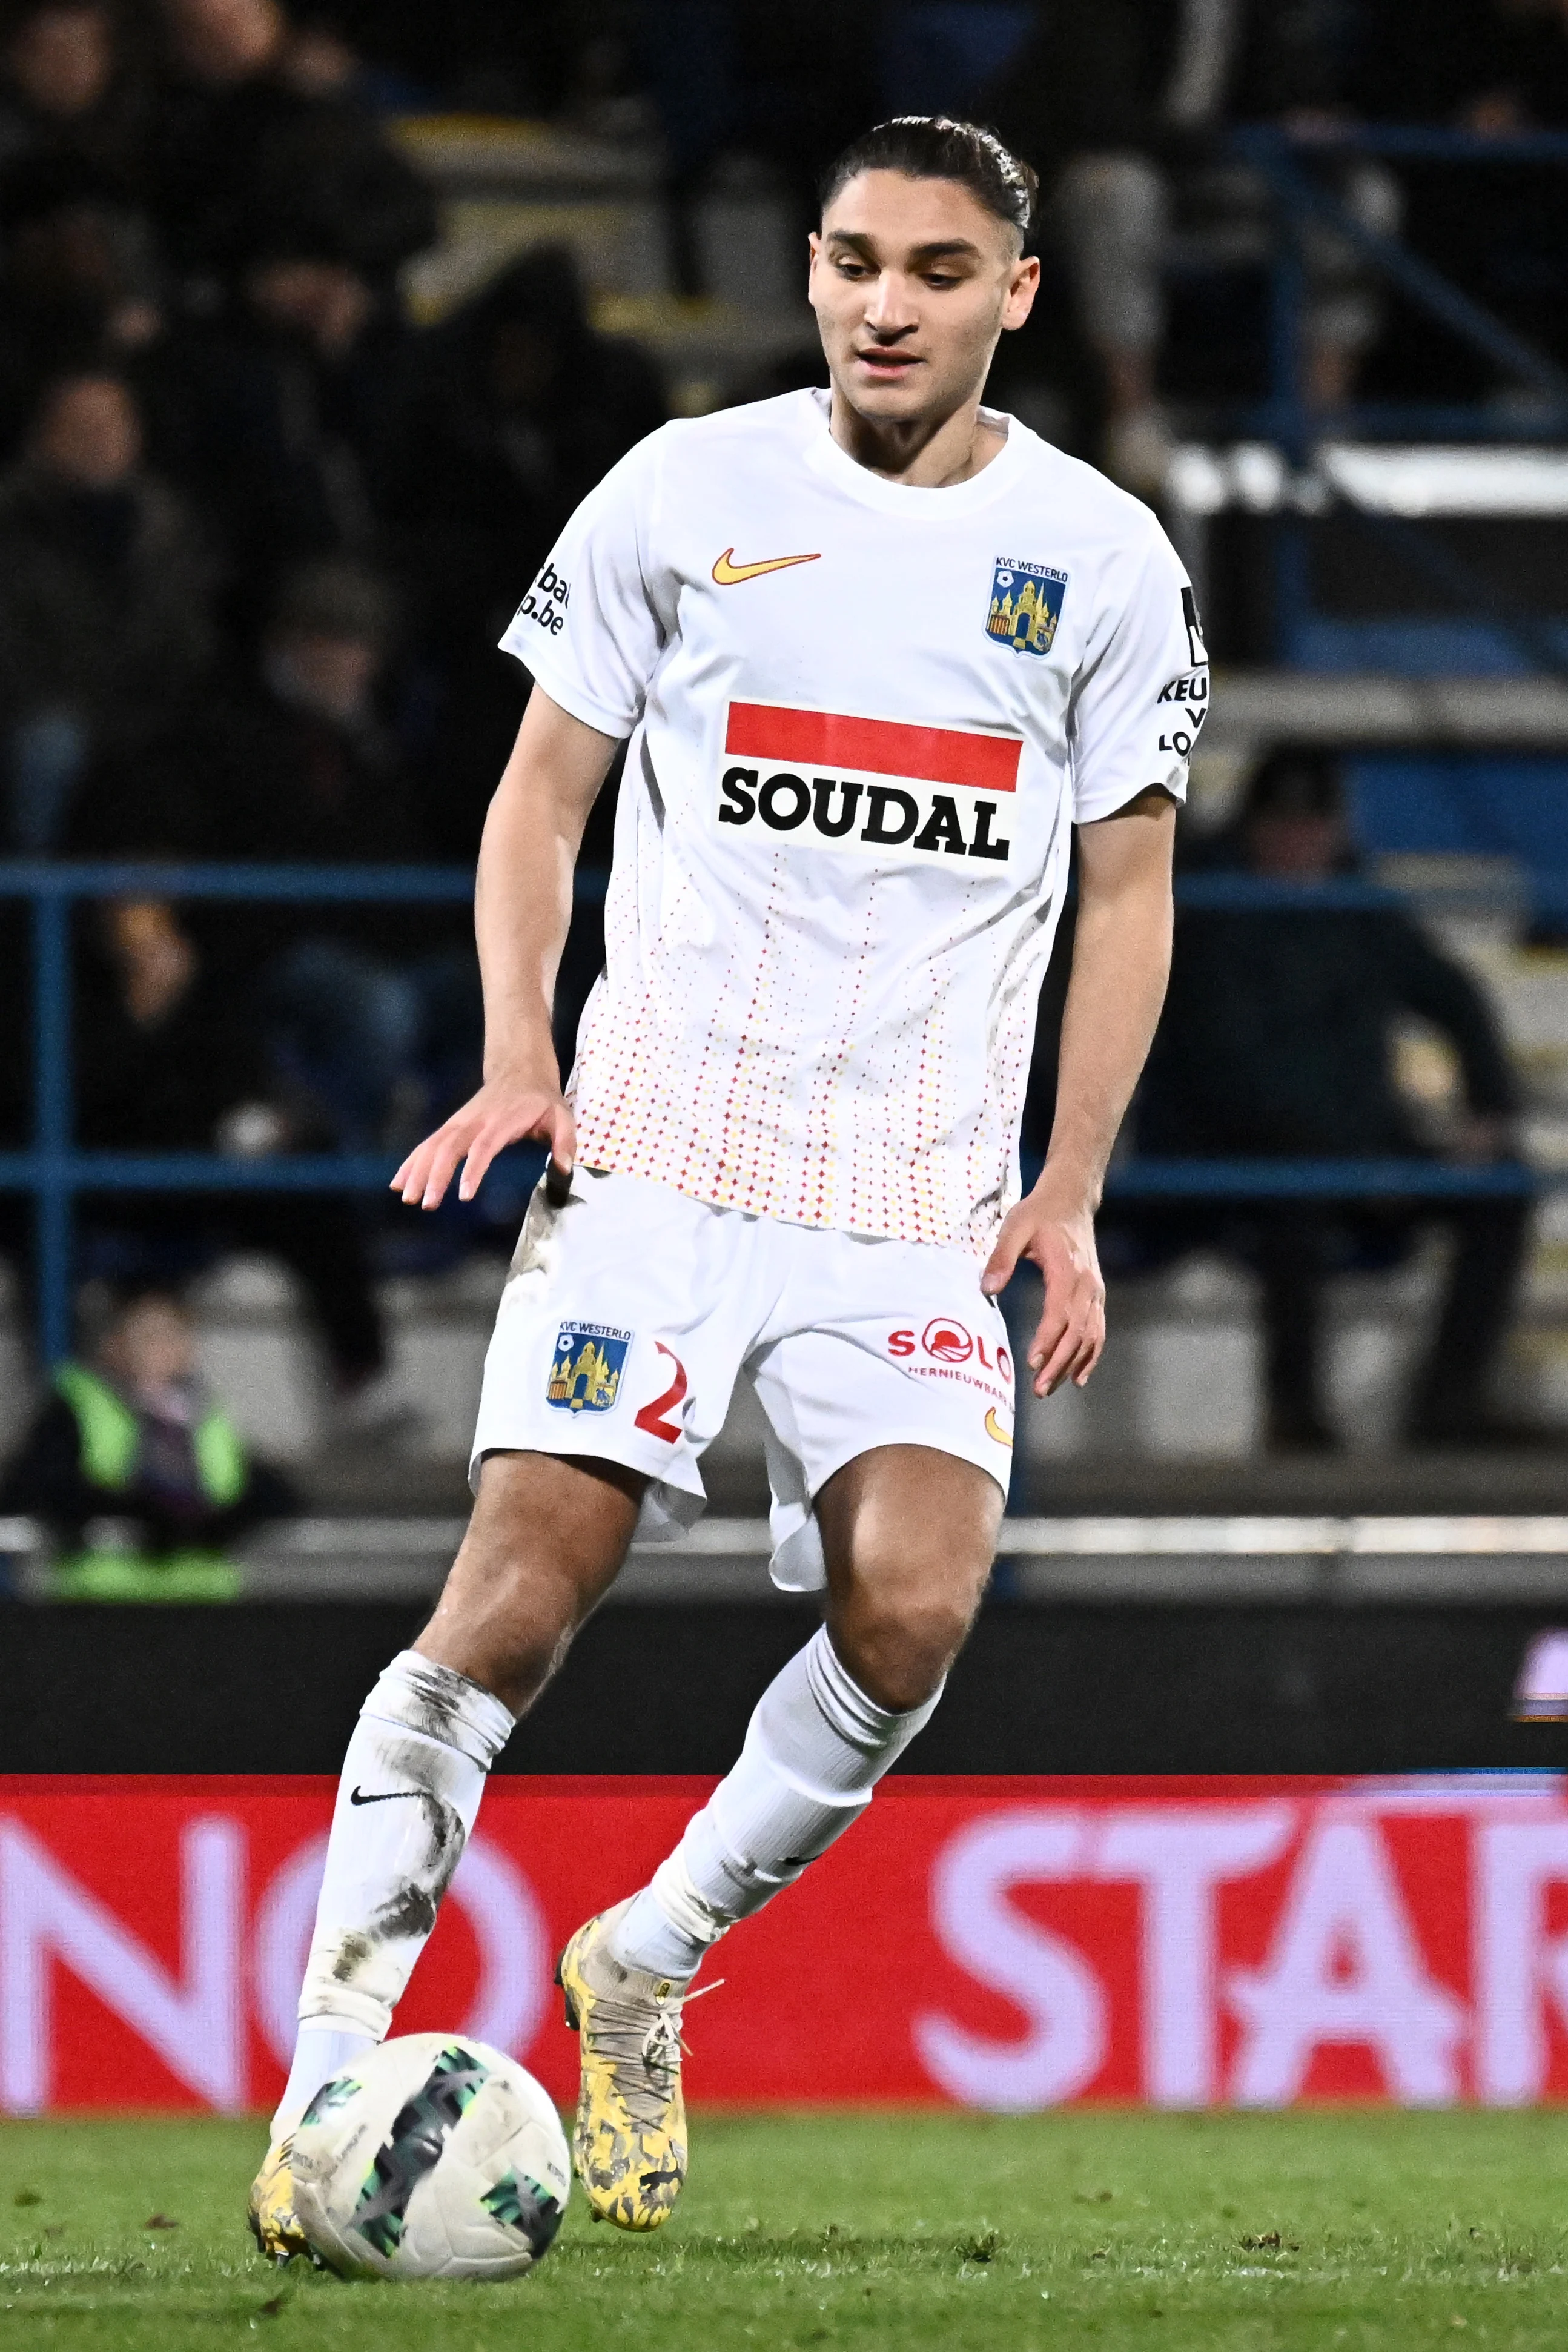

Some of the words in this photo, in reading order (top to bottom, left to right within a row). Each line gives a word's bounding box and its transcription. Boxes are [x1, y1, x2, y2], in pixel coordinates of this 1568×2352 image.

[535, 562, 571, 609] bal
[996, 557, 1016, 568] KVC
[1017, 560, 1068, 583] WESTERLO
[718, 767, 1010, 861] SOUDAL
[560, 1321, 577, 1331] KVC
[579, 1322, 632, 1340] WESTERLO
[633, 1340, 687, 1445] 2
